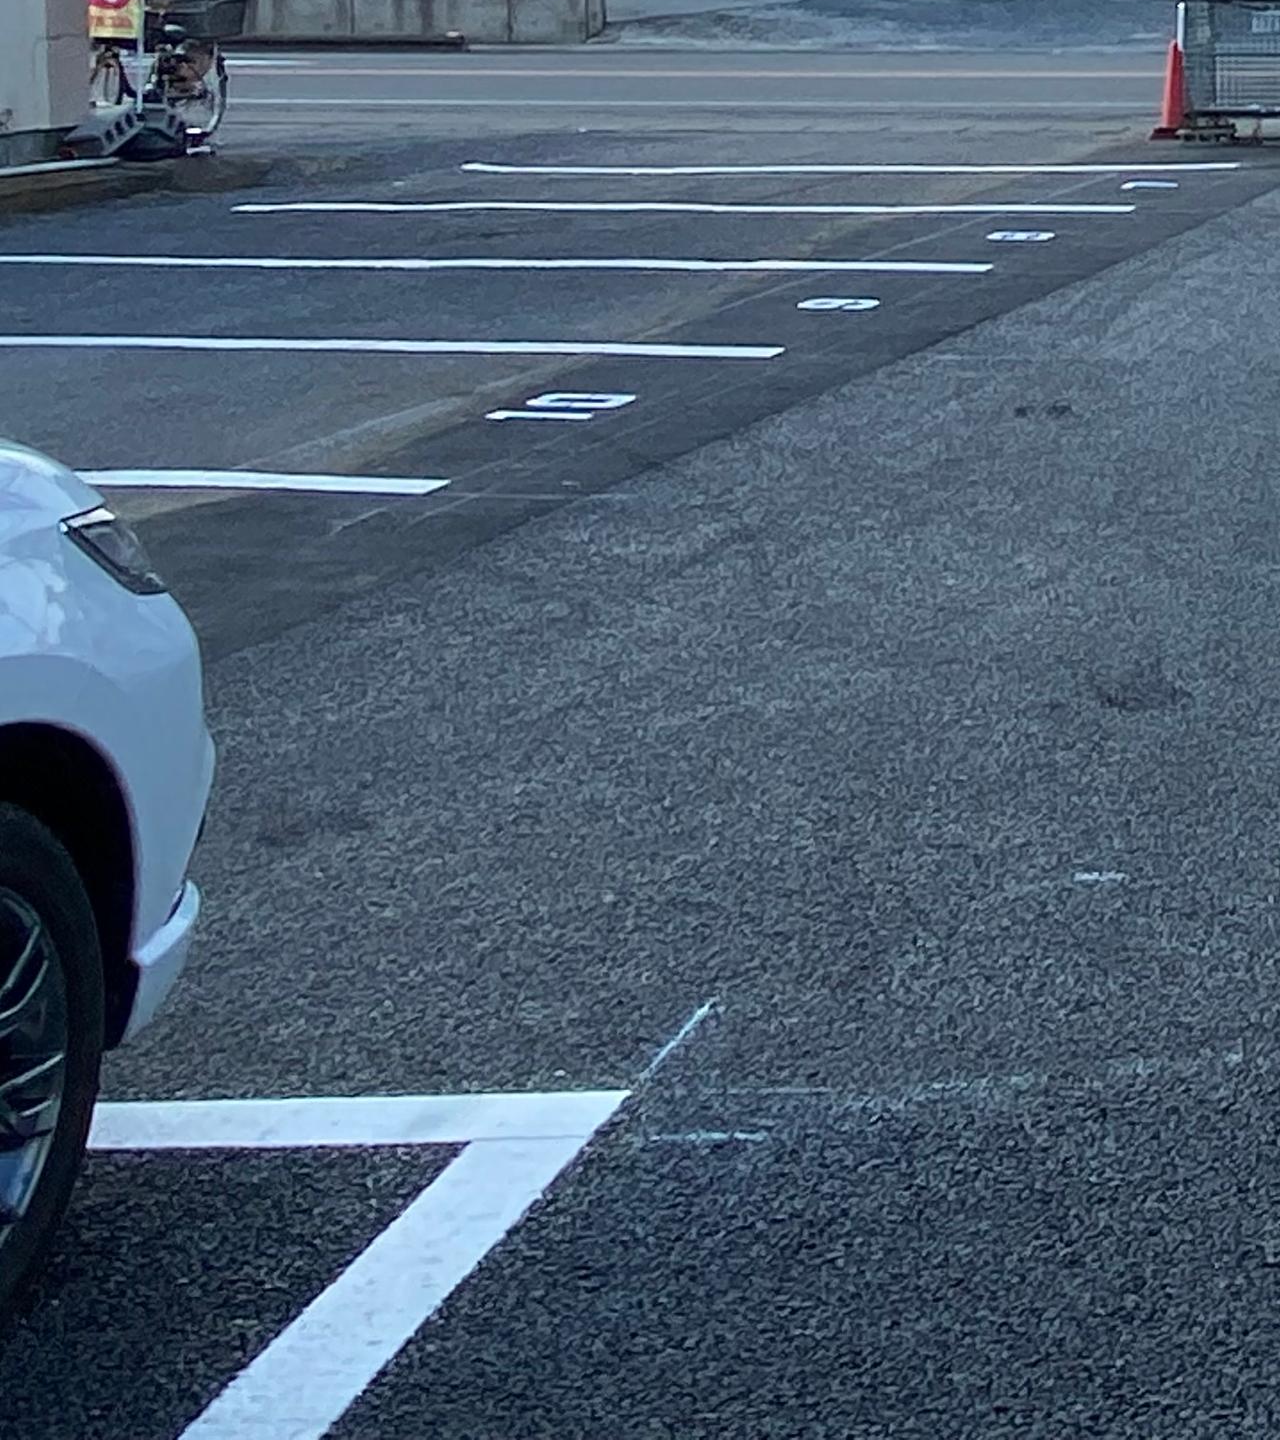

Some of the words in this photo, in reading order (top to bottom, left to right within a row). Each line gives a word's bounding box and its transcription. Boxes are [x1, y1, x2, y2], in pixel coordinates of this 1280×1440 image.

[986, 231, 1055, 241] 8
[797, 299, 880, 311] 9
[485, 393, 637, 421] 10
